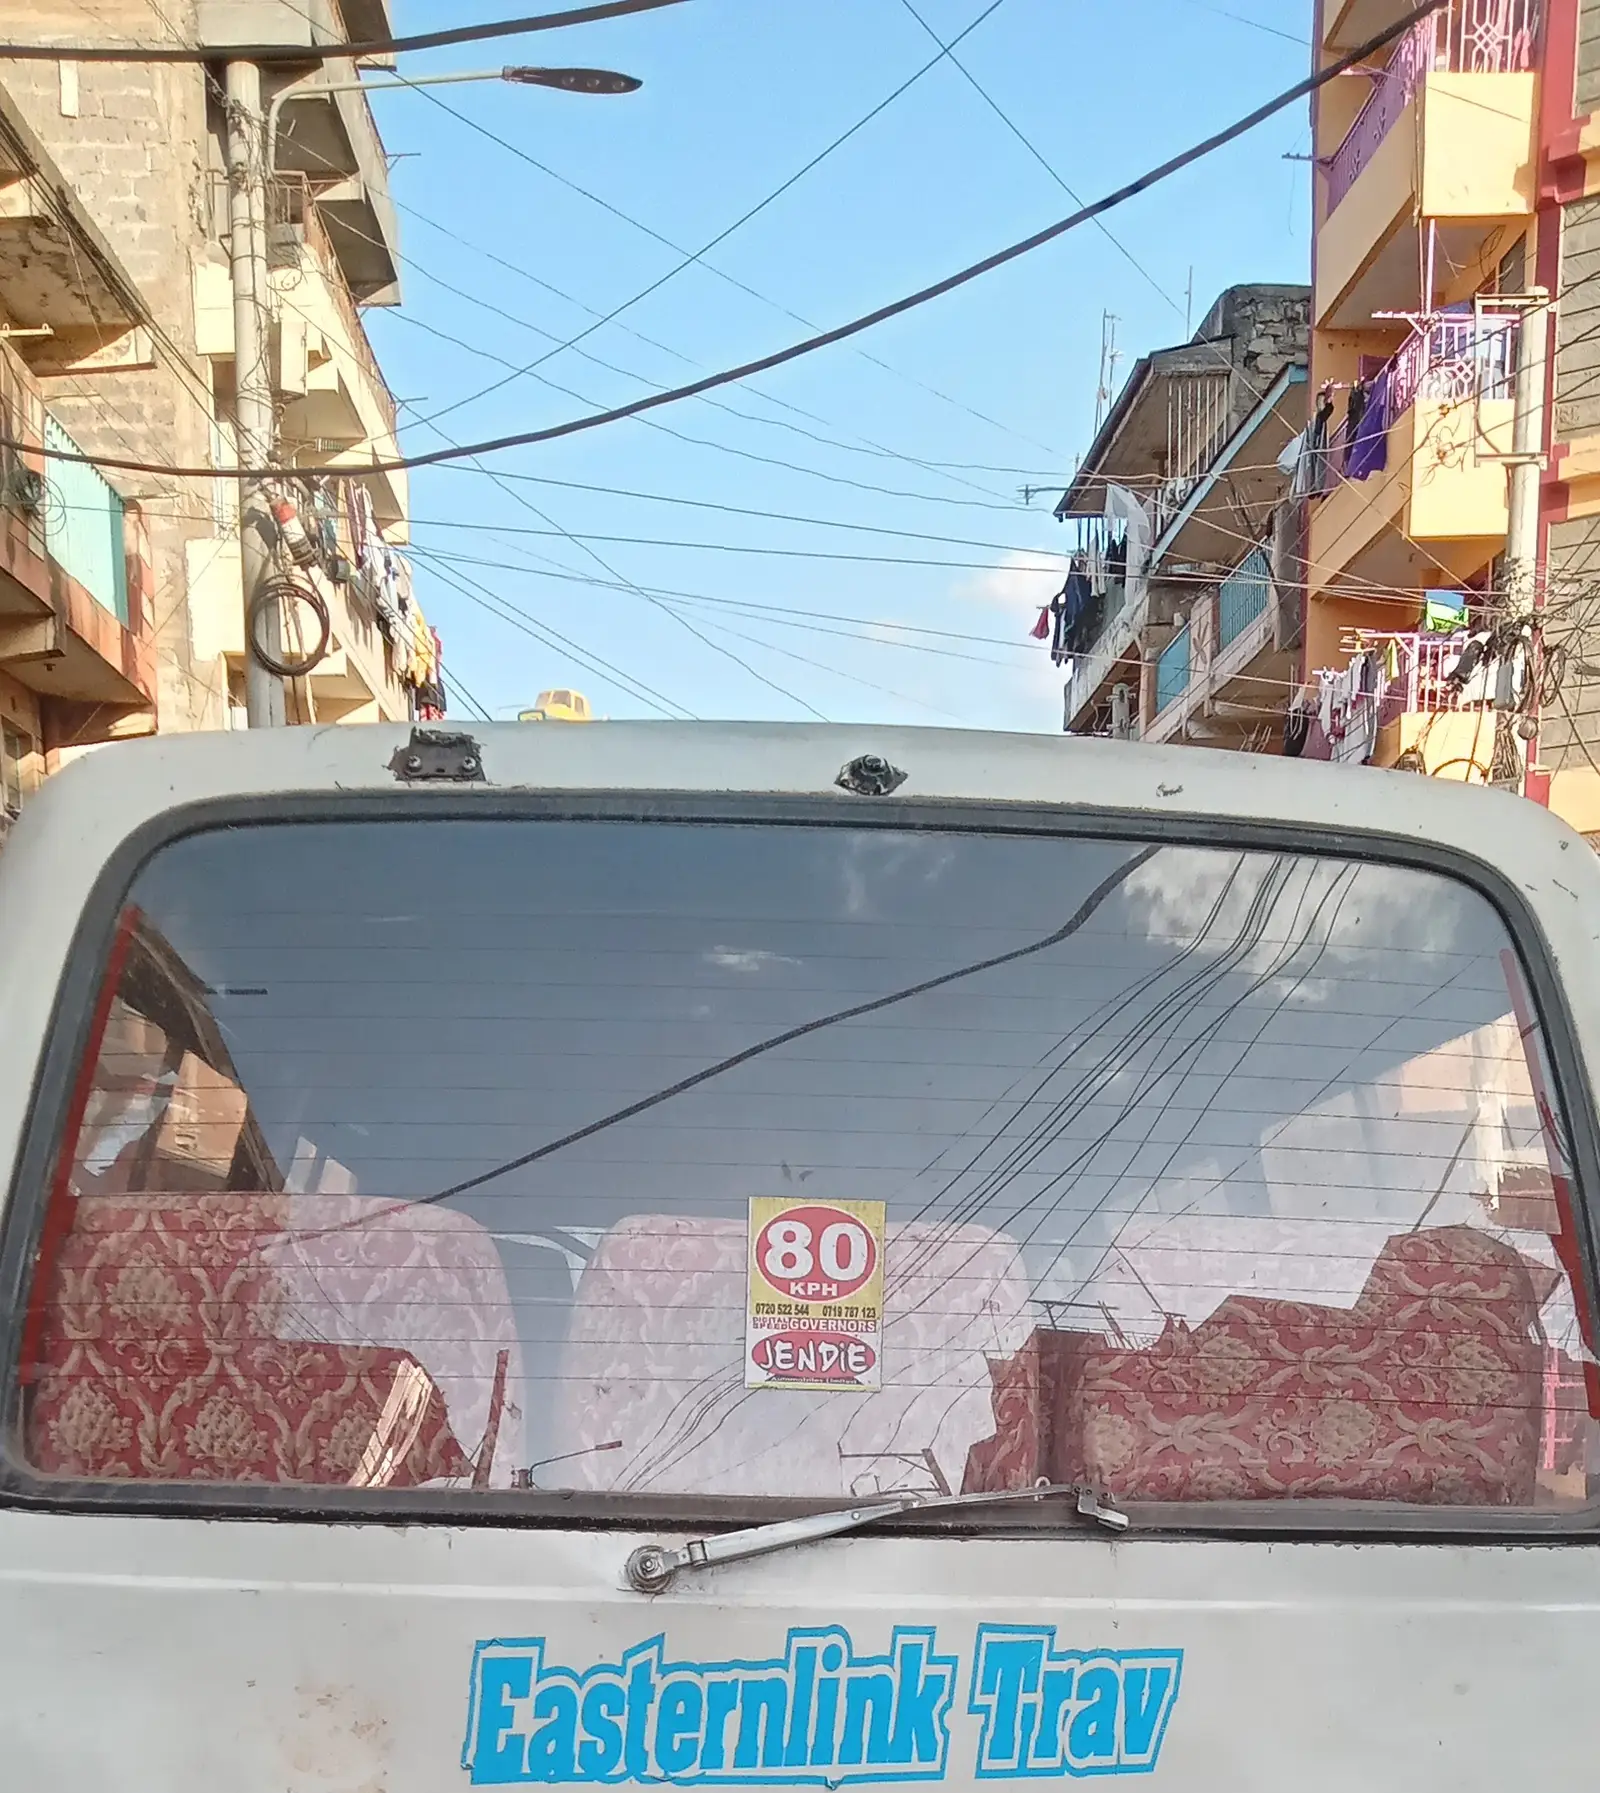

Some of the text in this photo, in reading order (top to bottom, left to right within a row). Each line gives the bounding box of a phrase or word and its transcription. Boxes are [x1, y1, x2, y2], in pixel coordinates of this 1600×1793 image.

[765, 1220, 868, 1280] 80
[789, 1282, 838, 1296] KPH
[755, 1303, 810, 1316] 0720 522 544
[822, 1305, 877, 1319] 0719 787 123
[752, 1322, 789, 1330] SPEED
[789, 1318, 876, 1332] GOVERNORS
[464, 1624, 1184, 1788] Easternlink Trav
